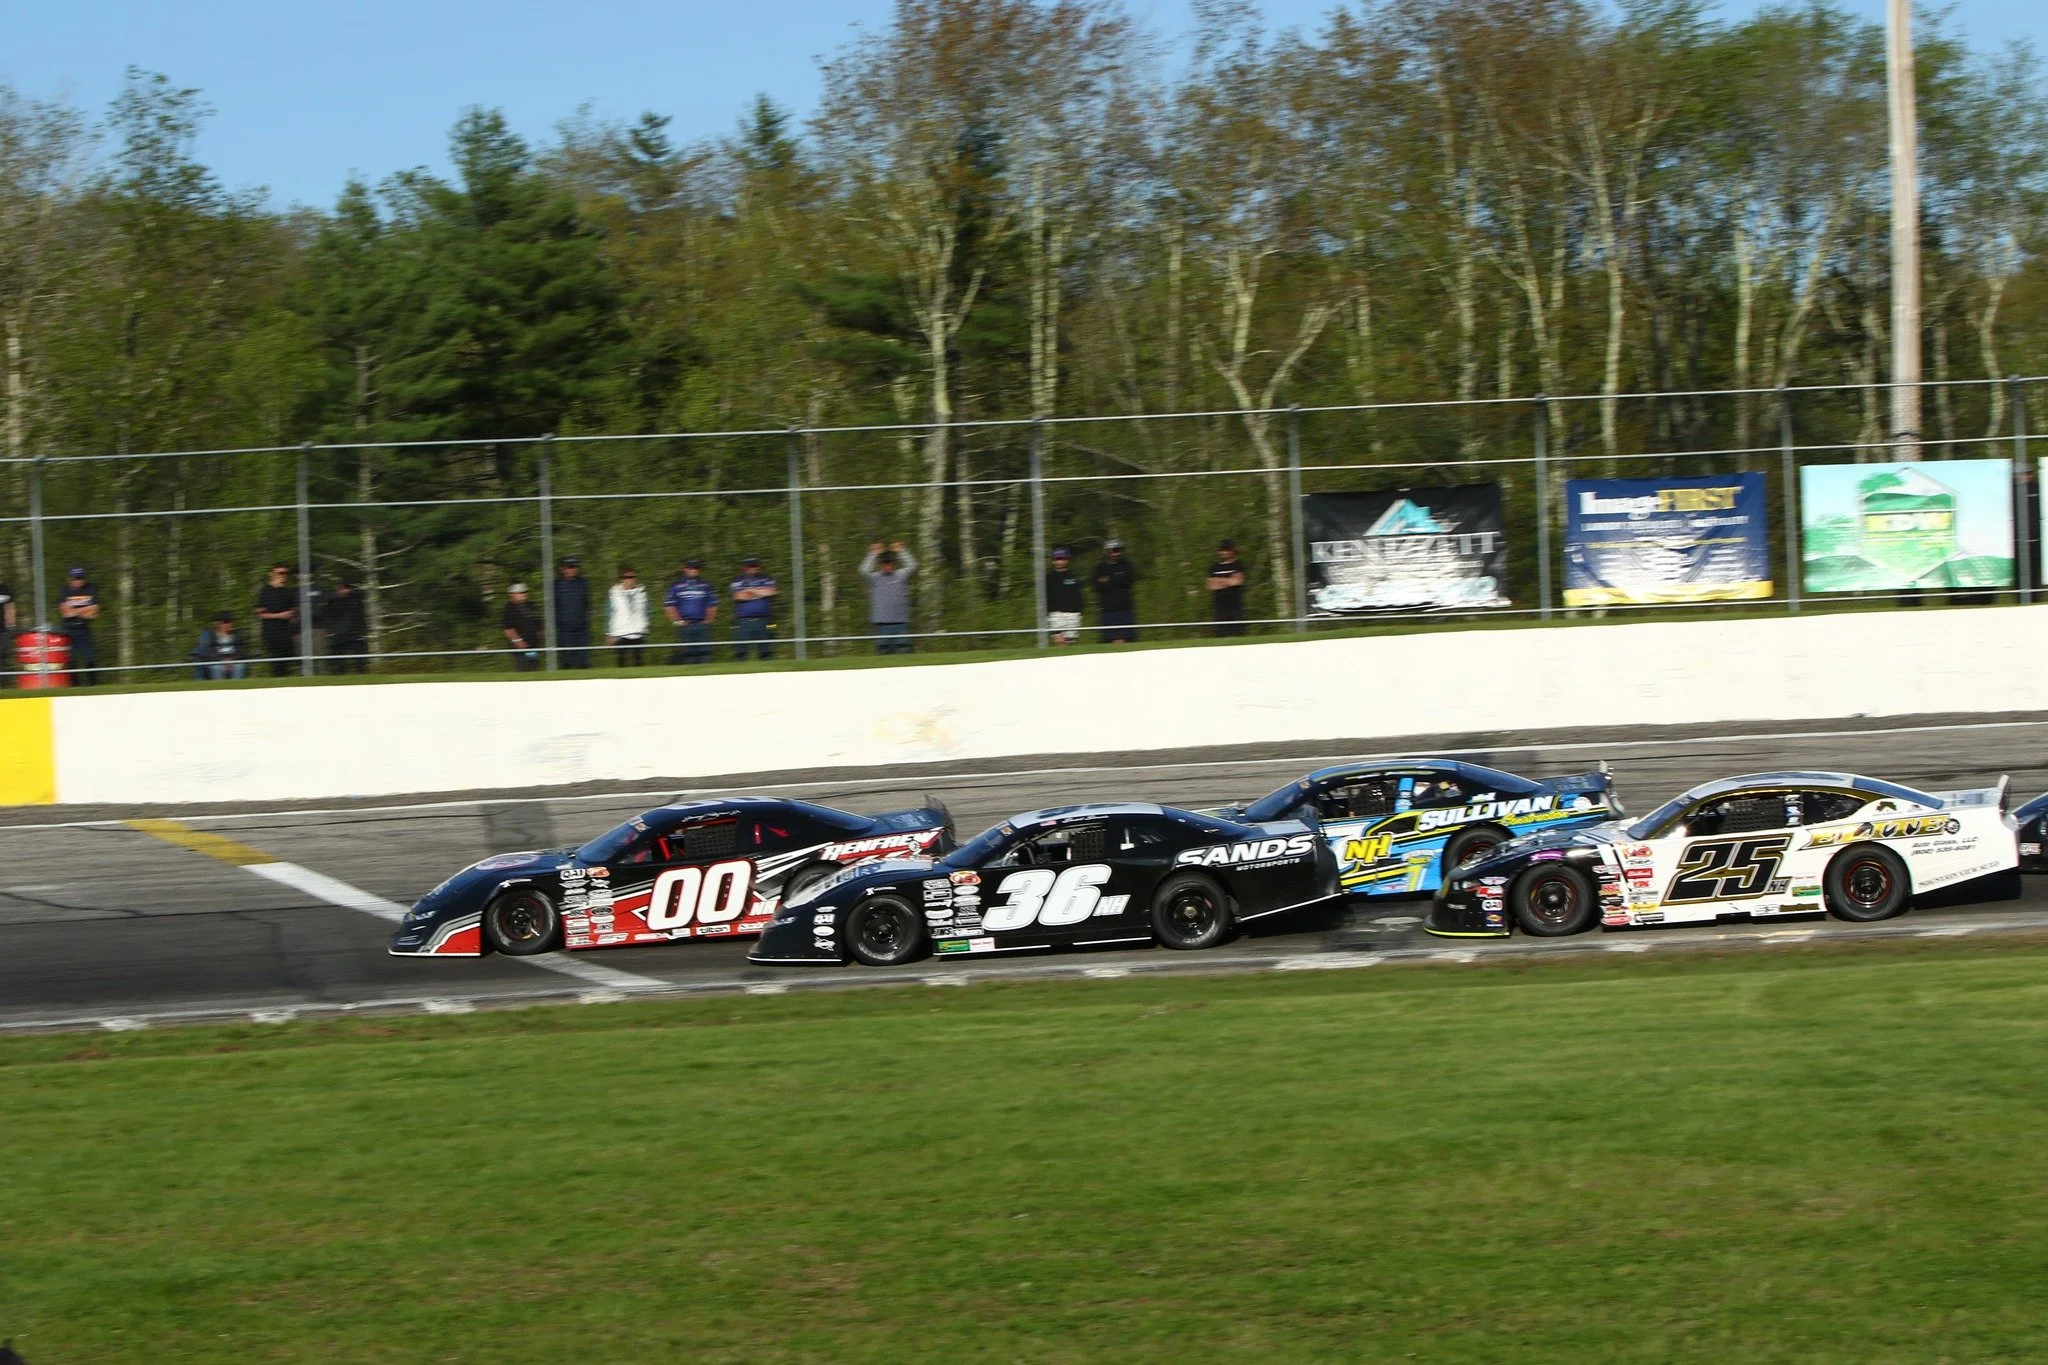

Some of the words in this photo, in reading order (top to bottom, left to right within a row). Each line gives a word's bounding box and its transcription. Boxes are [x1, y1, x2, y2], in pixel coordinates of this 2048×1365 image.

[1418, 796, 1554, 831] SULLIVAN
[820, 830, 940, 861] RENFREW
[1176, 834, 1317, 867] SANDS
[1344, 833, 1392, 865] NH
[1236, 857, 1301, 872] MOTORSPORTS
[1661, 833, 1793, 905] 25
[647, 860, 754, 931] 00
[981, 863, 1112, 931] 36
[1092, 894, 1131, 917] NH
